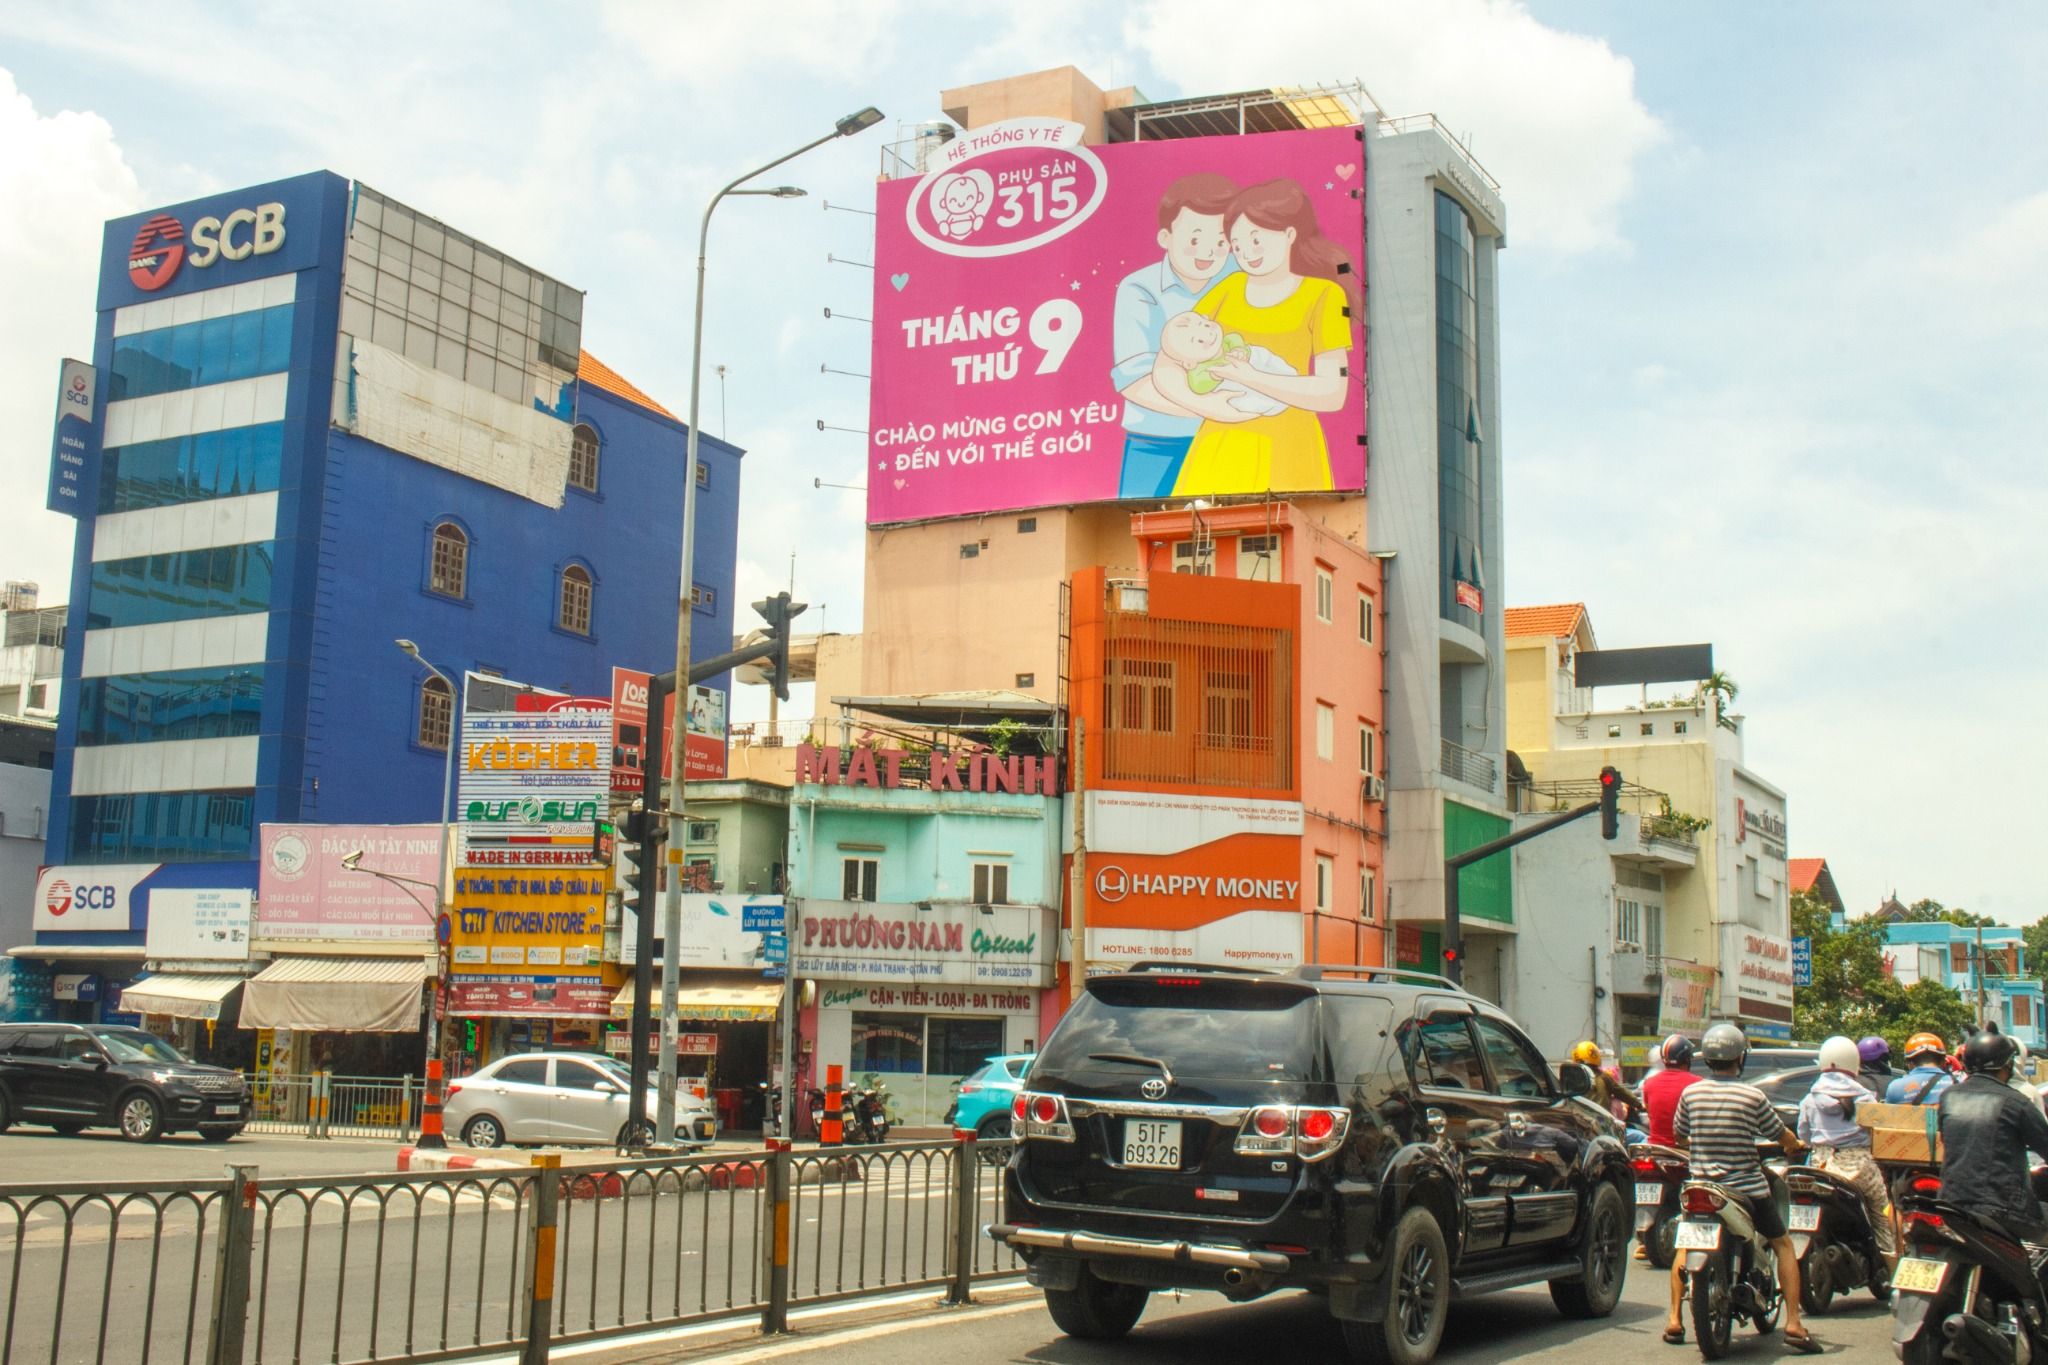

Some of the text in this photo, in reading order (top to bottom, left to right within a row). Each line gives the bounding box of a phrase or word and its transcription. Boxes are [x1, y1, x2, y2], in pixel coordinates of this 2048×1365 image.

[947, 124, 1066, 163] HỆ THỐNG Y TẾ
[998, 159, 1077, 187] PHỤ SẢN
[996, 177, 1079, 229] 315
[188, 202, 286, 268] SCB
[902, 306, 1021, 348] THÁNG
[1028, 297, 1083, 376] 9
[951, 345, 1022, 385] THỨ
[66, 390, 89, 406] SCB
[874, 402, 1118, 447] CHÀO MỪNG CON YÊU
[62, 436, 85, 450] NGÂN
[894, 431, 1092, 473] ĐẾN VỚI THẾ GIỚI
[60, 452, 83, 466] HÀNG
[63, 470, 77, 481] SÀI
[59, 486, 77, 498] GÒN
[472, 717, 494, 730] THIẾT
[467, 736, 600, 774] KÖCHER
[795, 729, 1056, 796] MẮT KÍNH
[321, 834, 439, 857] ĐẶC SẢN TÂY NINH
[466, 850, 593, 864] MADE IN GERMANY
[74, 885, 116, 910] SCB
[456, 876, 466, 895] HỆ
[469, 875, 495, 895] THỐNG
[498, 875, 518, 895] THIẾT
[530, 877, 546, 895] NHÀ
[549, 876, 563, 895] BẾP
[1132, 874, 1299, 900] HAPPY MONEY
[493, 911, 586, 935] KITCHEN STORE
[804, 912, 963, 952] PHƯƠNG NAM
[971, 928, 1036, 959] Optical
[1102, 945, 1146, 956] HOTLINE:
[1150, 947, 1169, 956] 1800
[1224, 949, 1293, 961] Happymoney.vn
[81, 983, 96, 992] ATM
[869, 987, 894, 1011] CẬN
[901, 985, 928, 1006] VIỄN
[935, 990, 966, 1011] LOẠN
[973, 992, 988, 1008] ĐA
[991, 986, 1030, 1010] TRÒNG
[1138, 1123, 1169, 1144] 51F
[1126, 1143, 1179, 1165] 693.26
